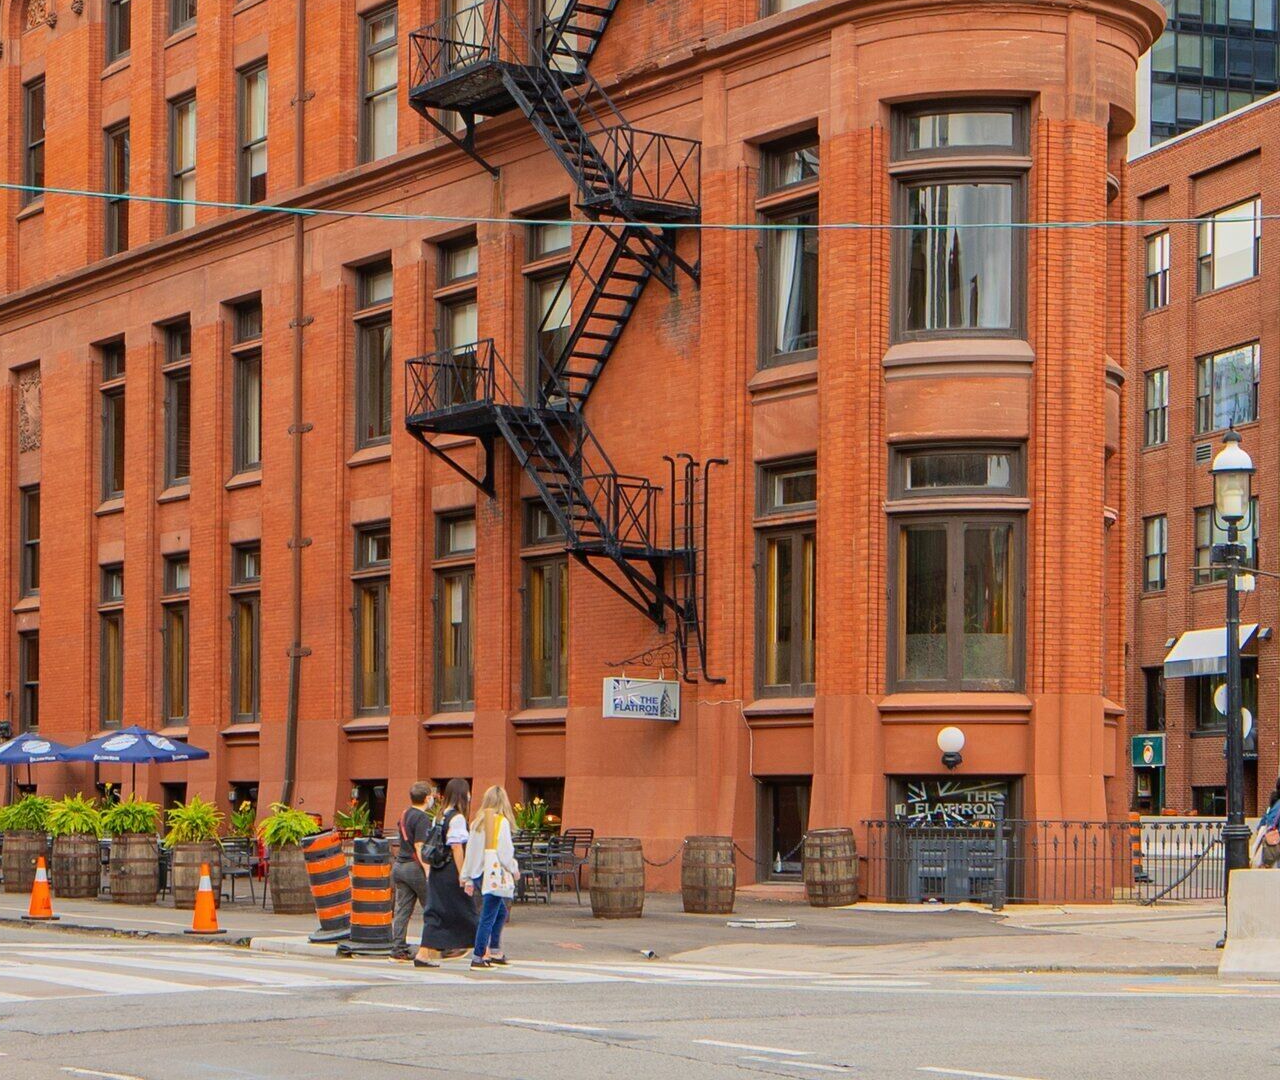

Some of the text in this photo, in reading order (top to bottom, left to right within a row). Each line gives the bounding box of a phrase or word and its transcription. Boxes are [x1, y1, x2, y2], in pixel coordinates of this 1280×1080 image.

[640, 696, 659, 704] THE
[614, 703, 659, 713] FLATIRON
[964, 791, 997, 802] THE
[915, 803, 996, 814] FLATIRON
